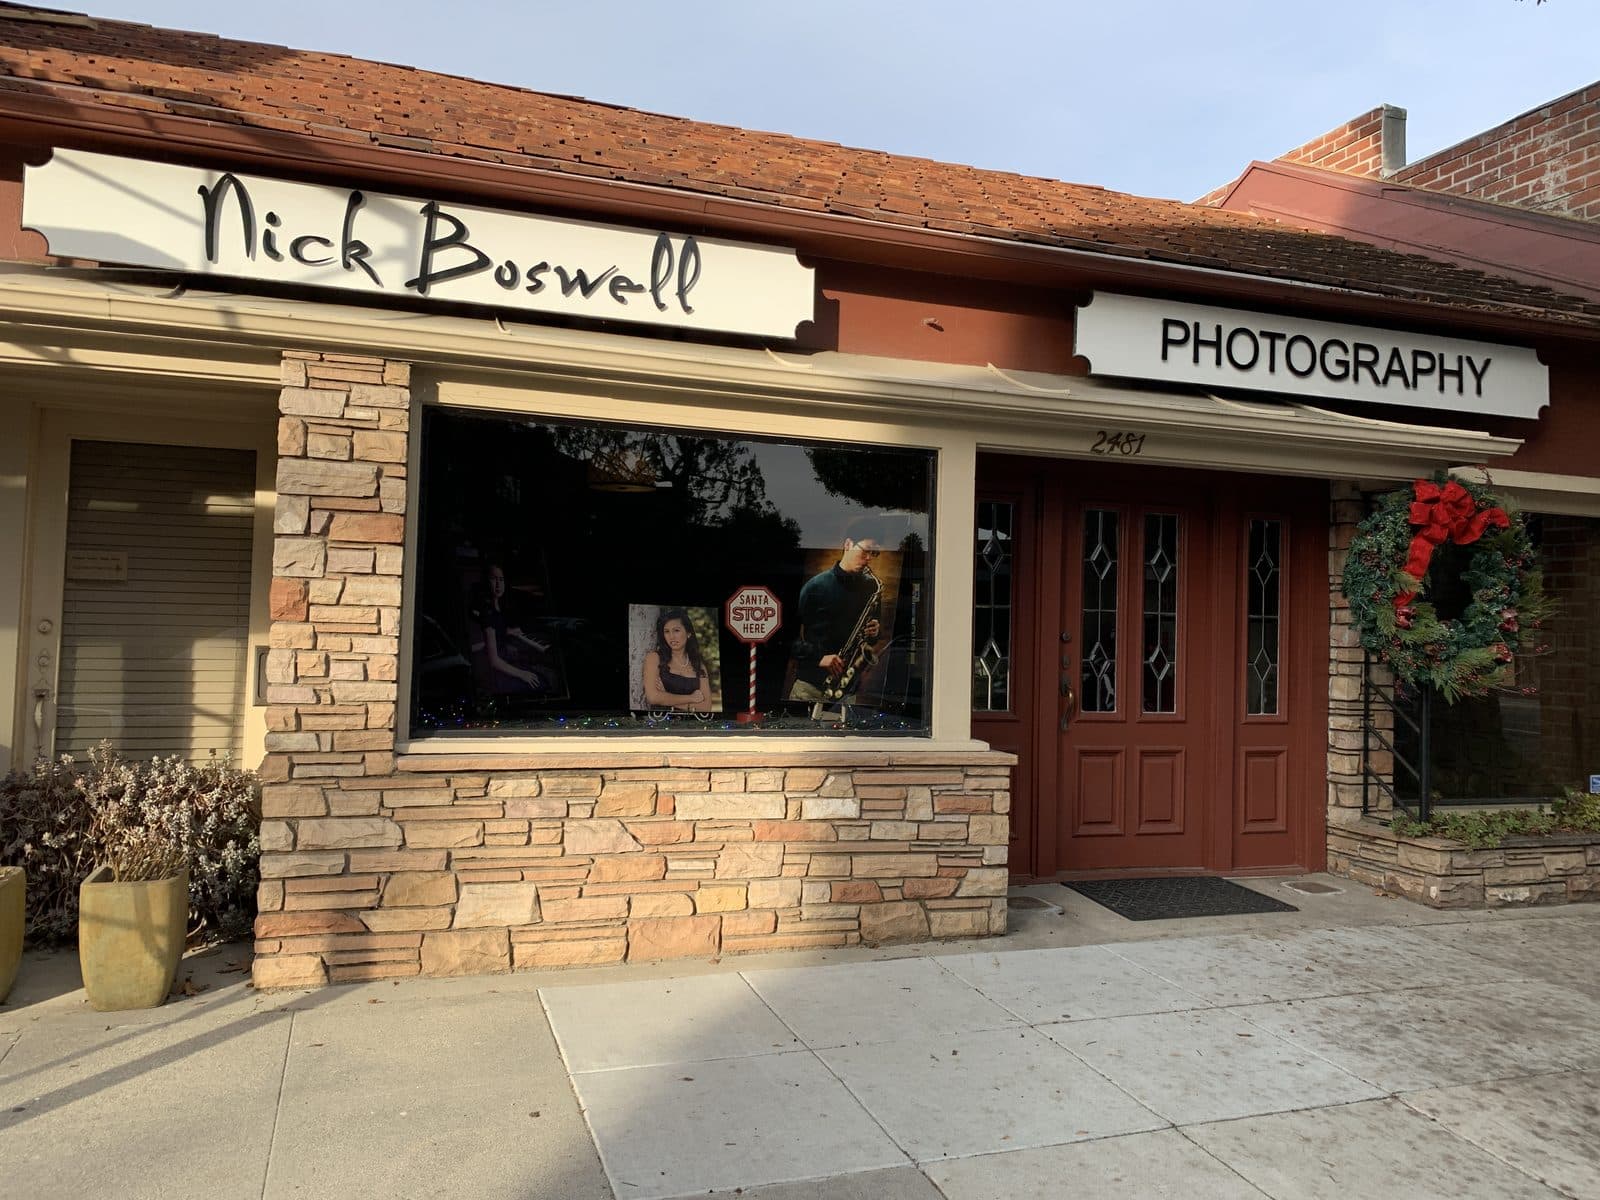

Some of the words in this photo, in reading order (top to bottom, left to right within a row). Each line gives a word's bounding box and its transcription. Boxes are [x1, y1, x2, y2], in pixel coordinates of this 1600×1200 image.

[198, 173, 383, 287] Nick
[405, 201, 702, 313] Boswell
[1162, 318, 1492, 397] PHOTOGRAPHY
[1090, 430, 1146, 456] 2481
[739, 594, 769, 605] SANTA
[732, 606, 776, 622] STOP
[743, 623, 766, 634] HERE
